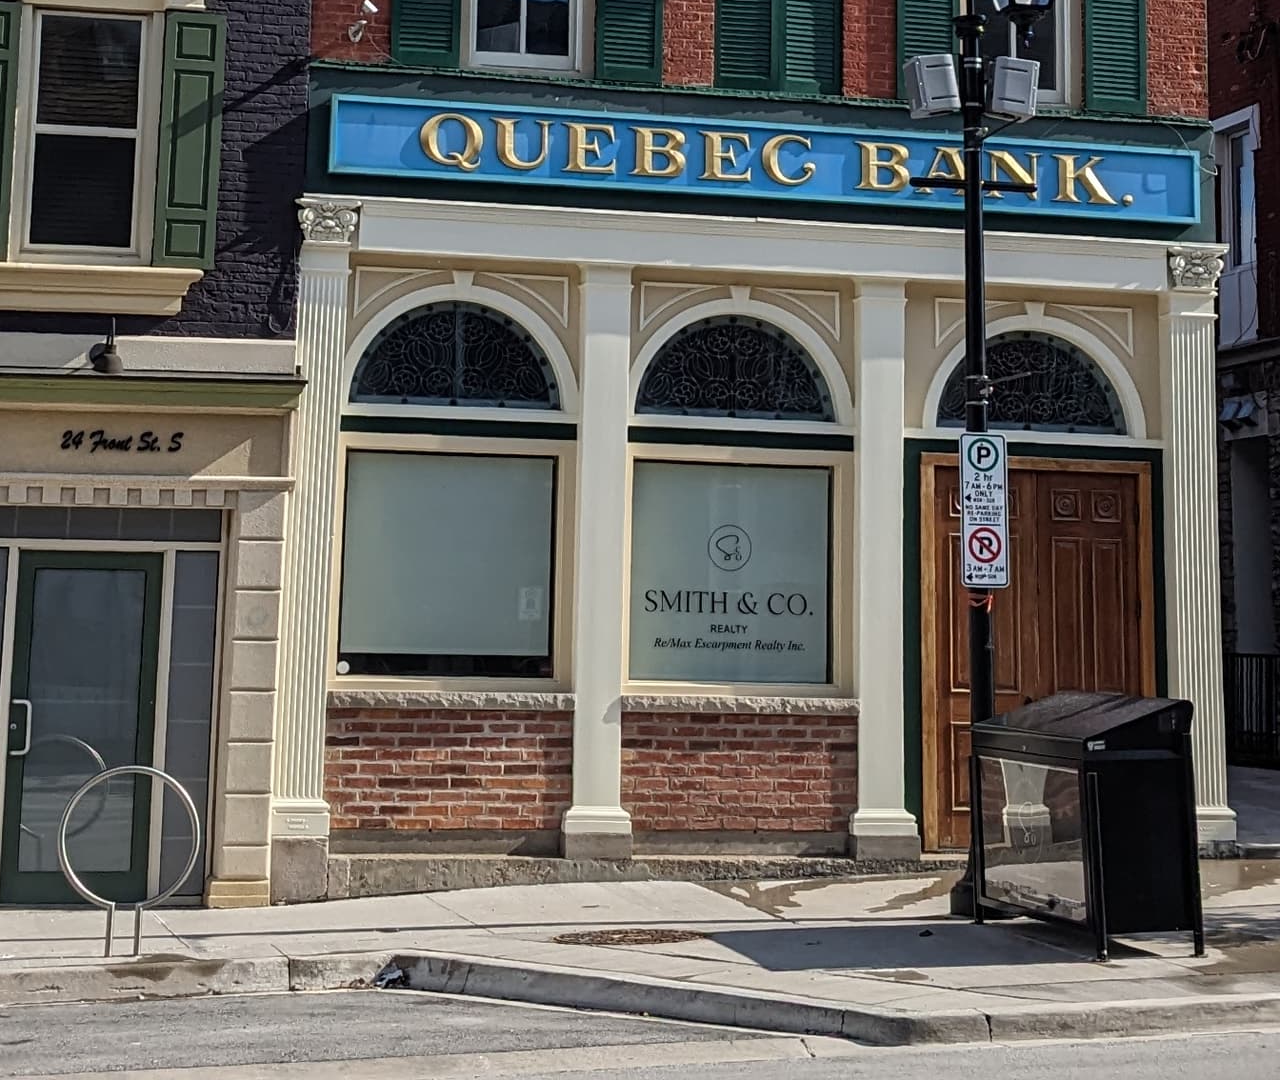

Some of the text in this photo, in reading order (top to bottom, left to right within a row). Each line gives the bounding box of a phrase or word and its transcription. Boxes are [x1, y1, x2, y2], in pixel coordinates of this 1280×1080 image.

[419, 112, 817, 187] QUEBEC
[60, 430, 185, 453] 24 Front St. S
[974, 472, 993, 481] 2 hr
[974, 490, 993, 498] ONLY
[644, 589, 814, 616] SMITH & CO.
[710, 624, 748, 634] REALTY
[654, 637, 806, 653] Re/Max Escarpment Realty Inc.
